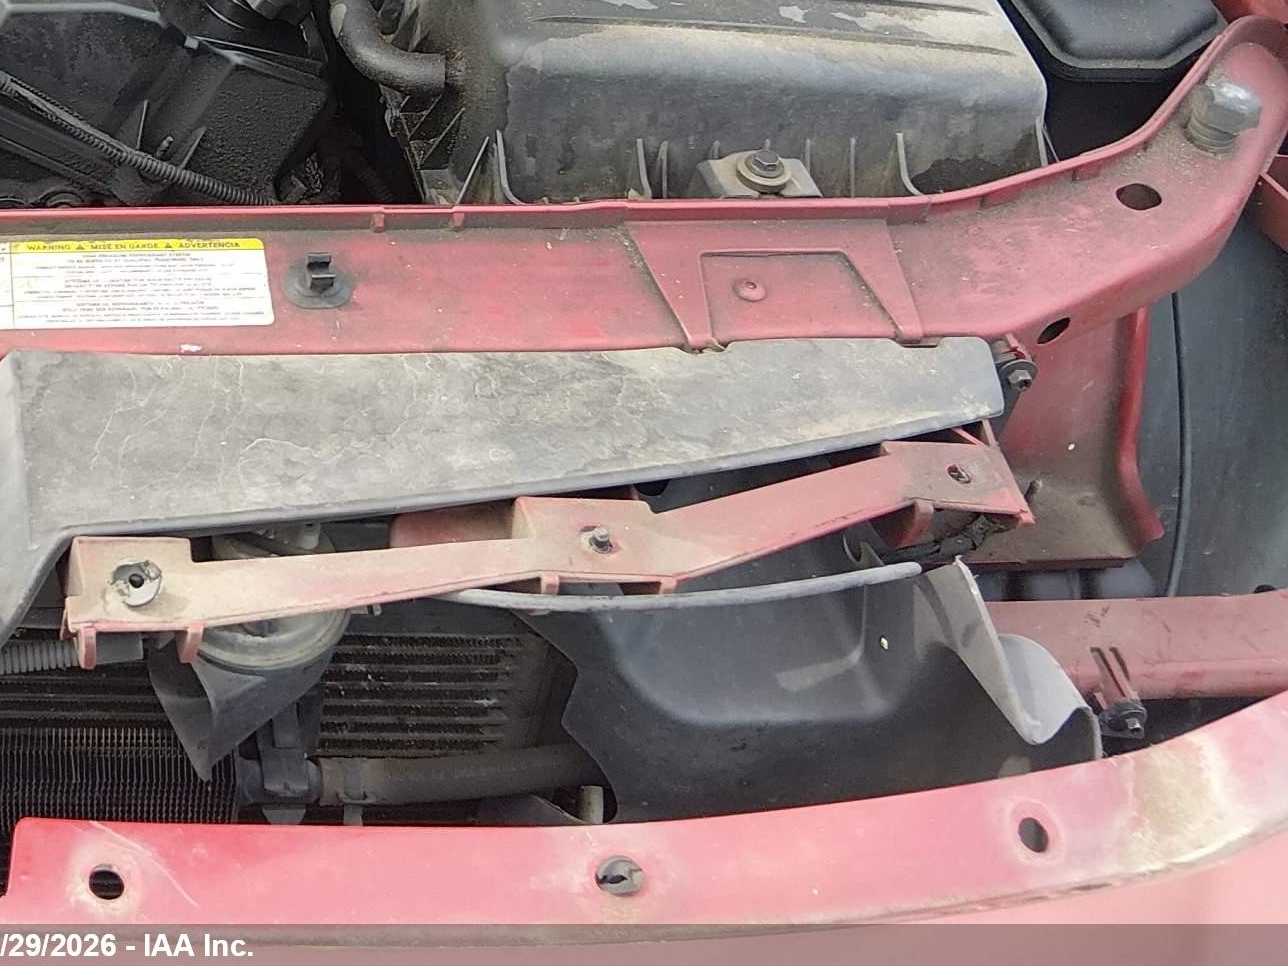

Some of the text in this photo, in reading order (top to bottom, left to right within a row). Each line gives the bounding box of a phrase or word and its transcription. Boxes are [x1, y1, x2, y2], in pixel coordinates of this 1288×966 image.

[27, 240, 241, 252] WARNING MISE EN GARDE ADVERTENCIA
